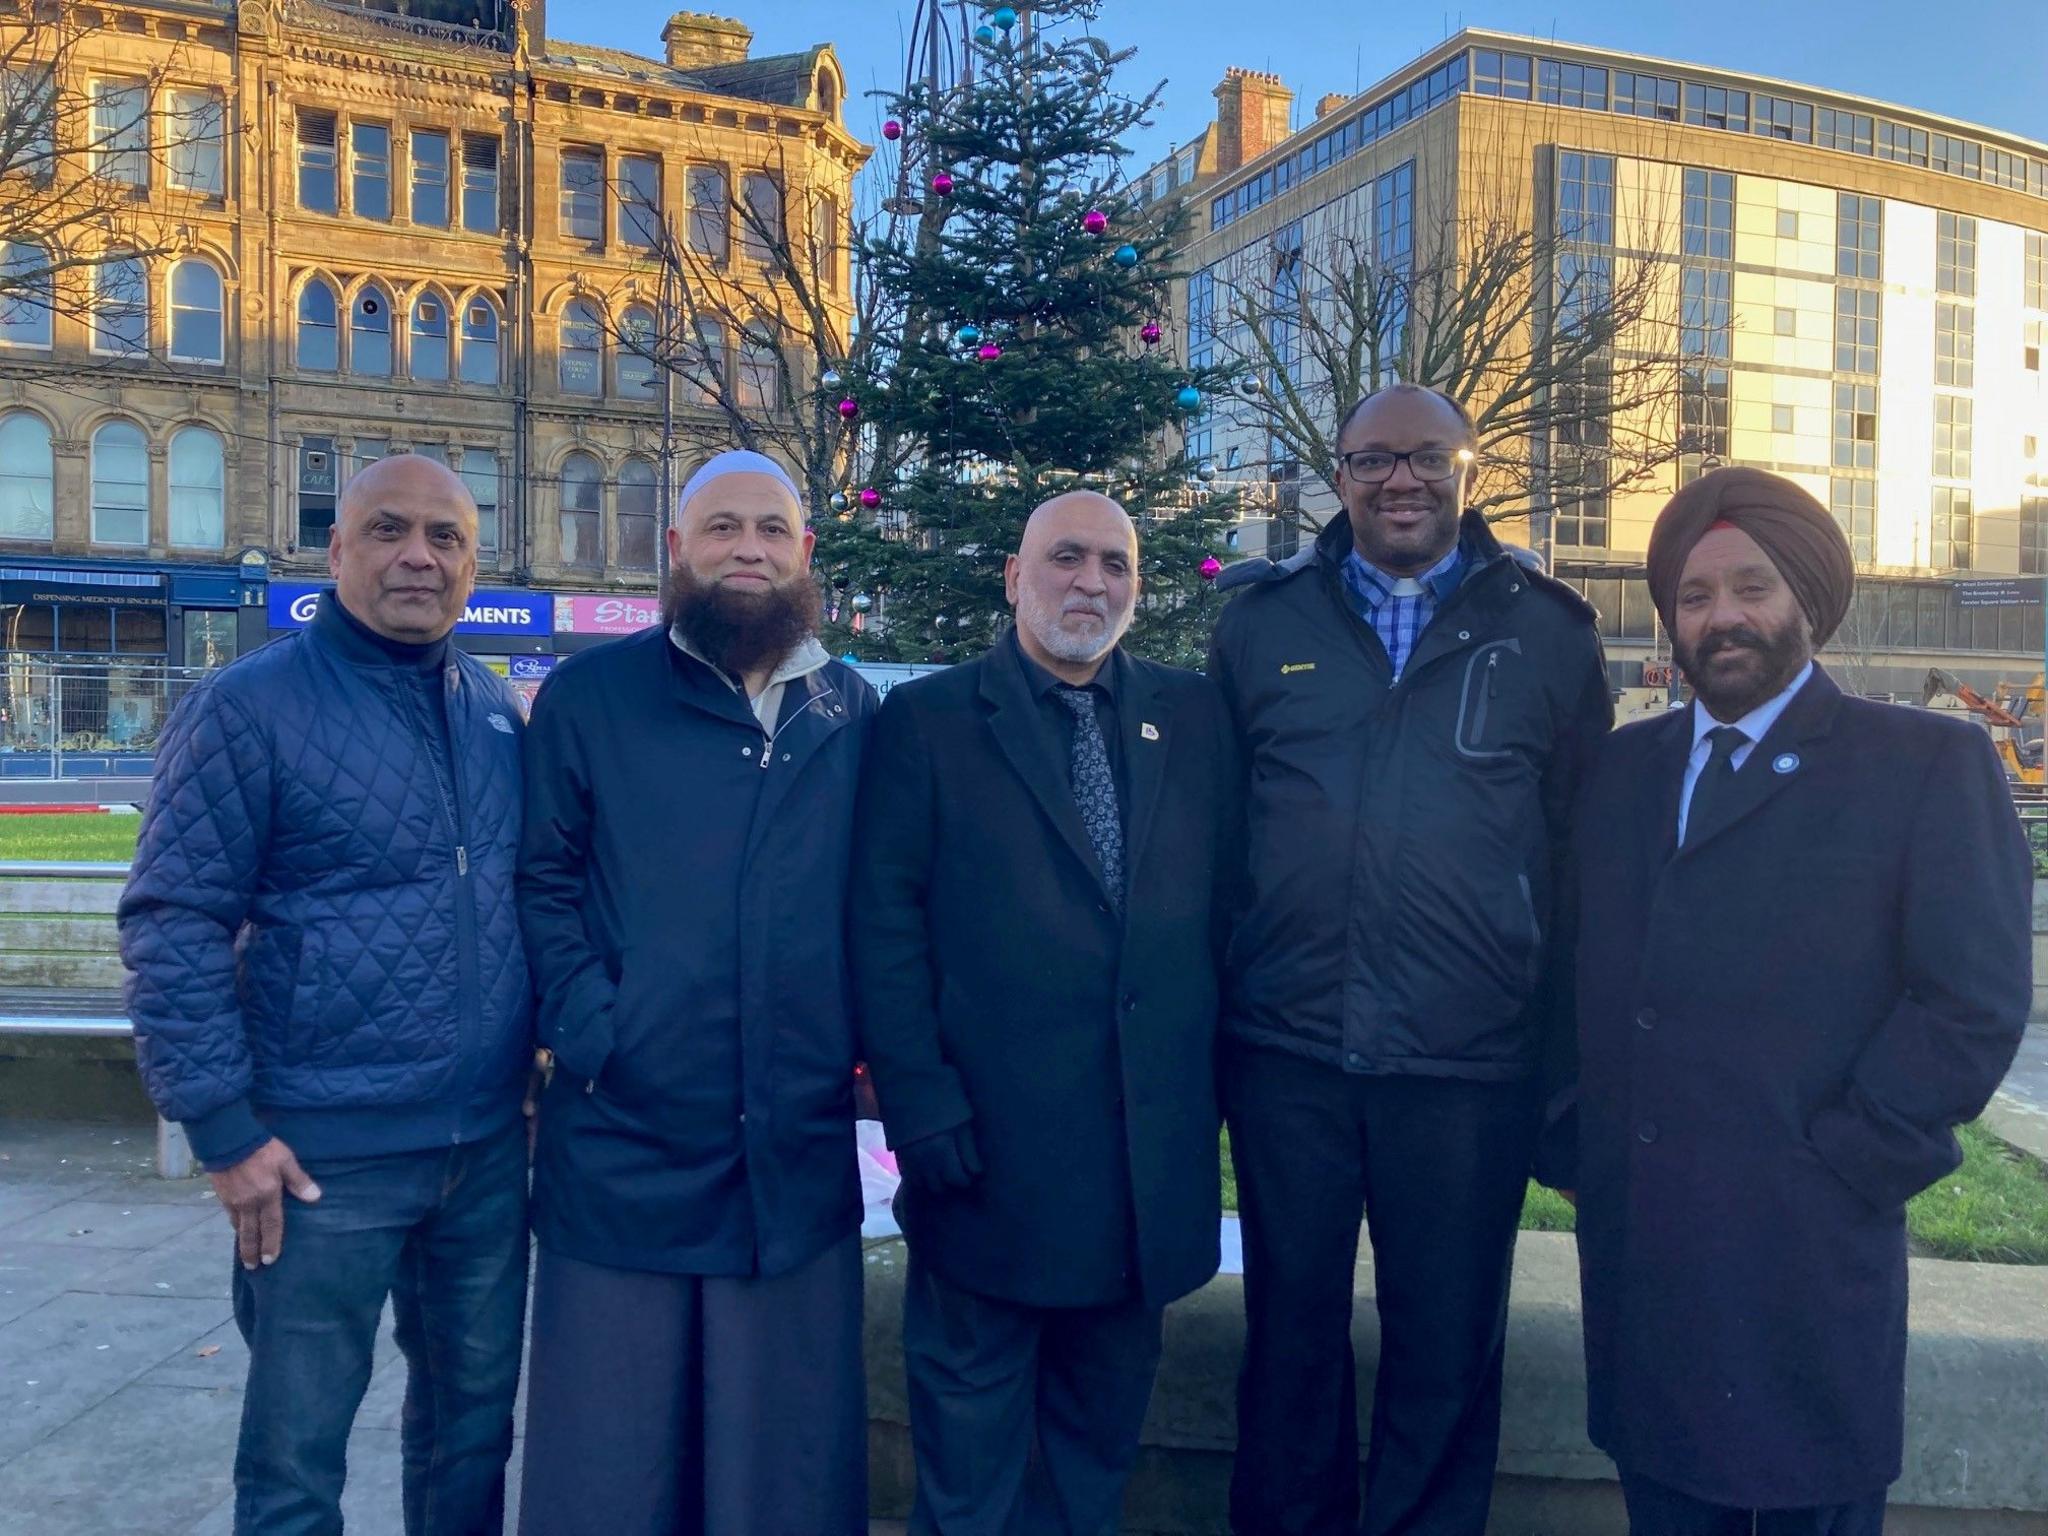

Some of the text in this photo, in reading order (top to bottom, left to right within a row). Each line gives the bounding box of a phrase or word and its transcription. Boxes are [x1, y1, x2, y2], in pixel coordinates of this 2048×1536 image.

[32, 593, 81, 602] DISPENSING
[81, 595, 125, 604] MEDICINES
[456, 606, 531, 625] MENTS
